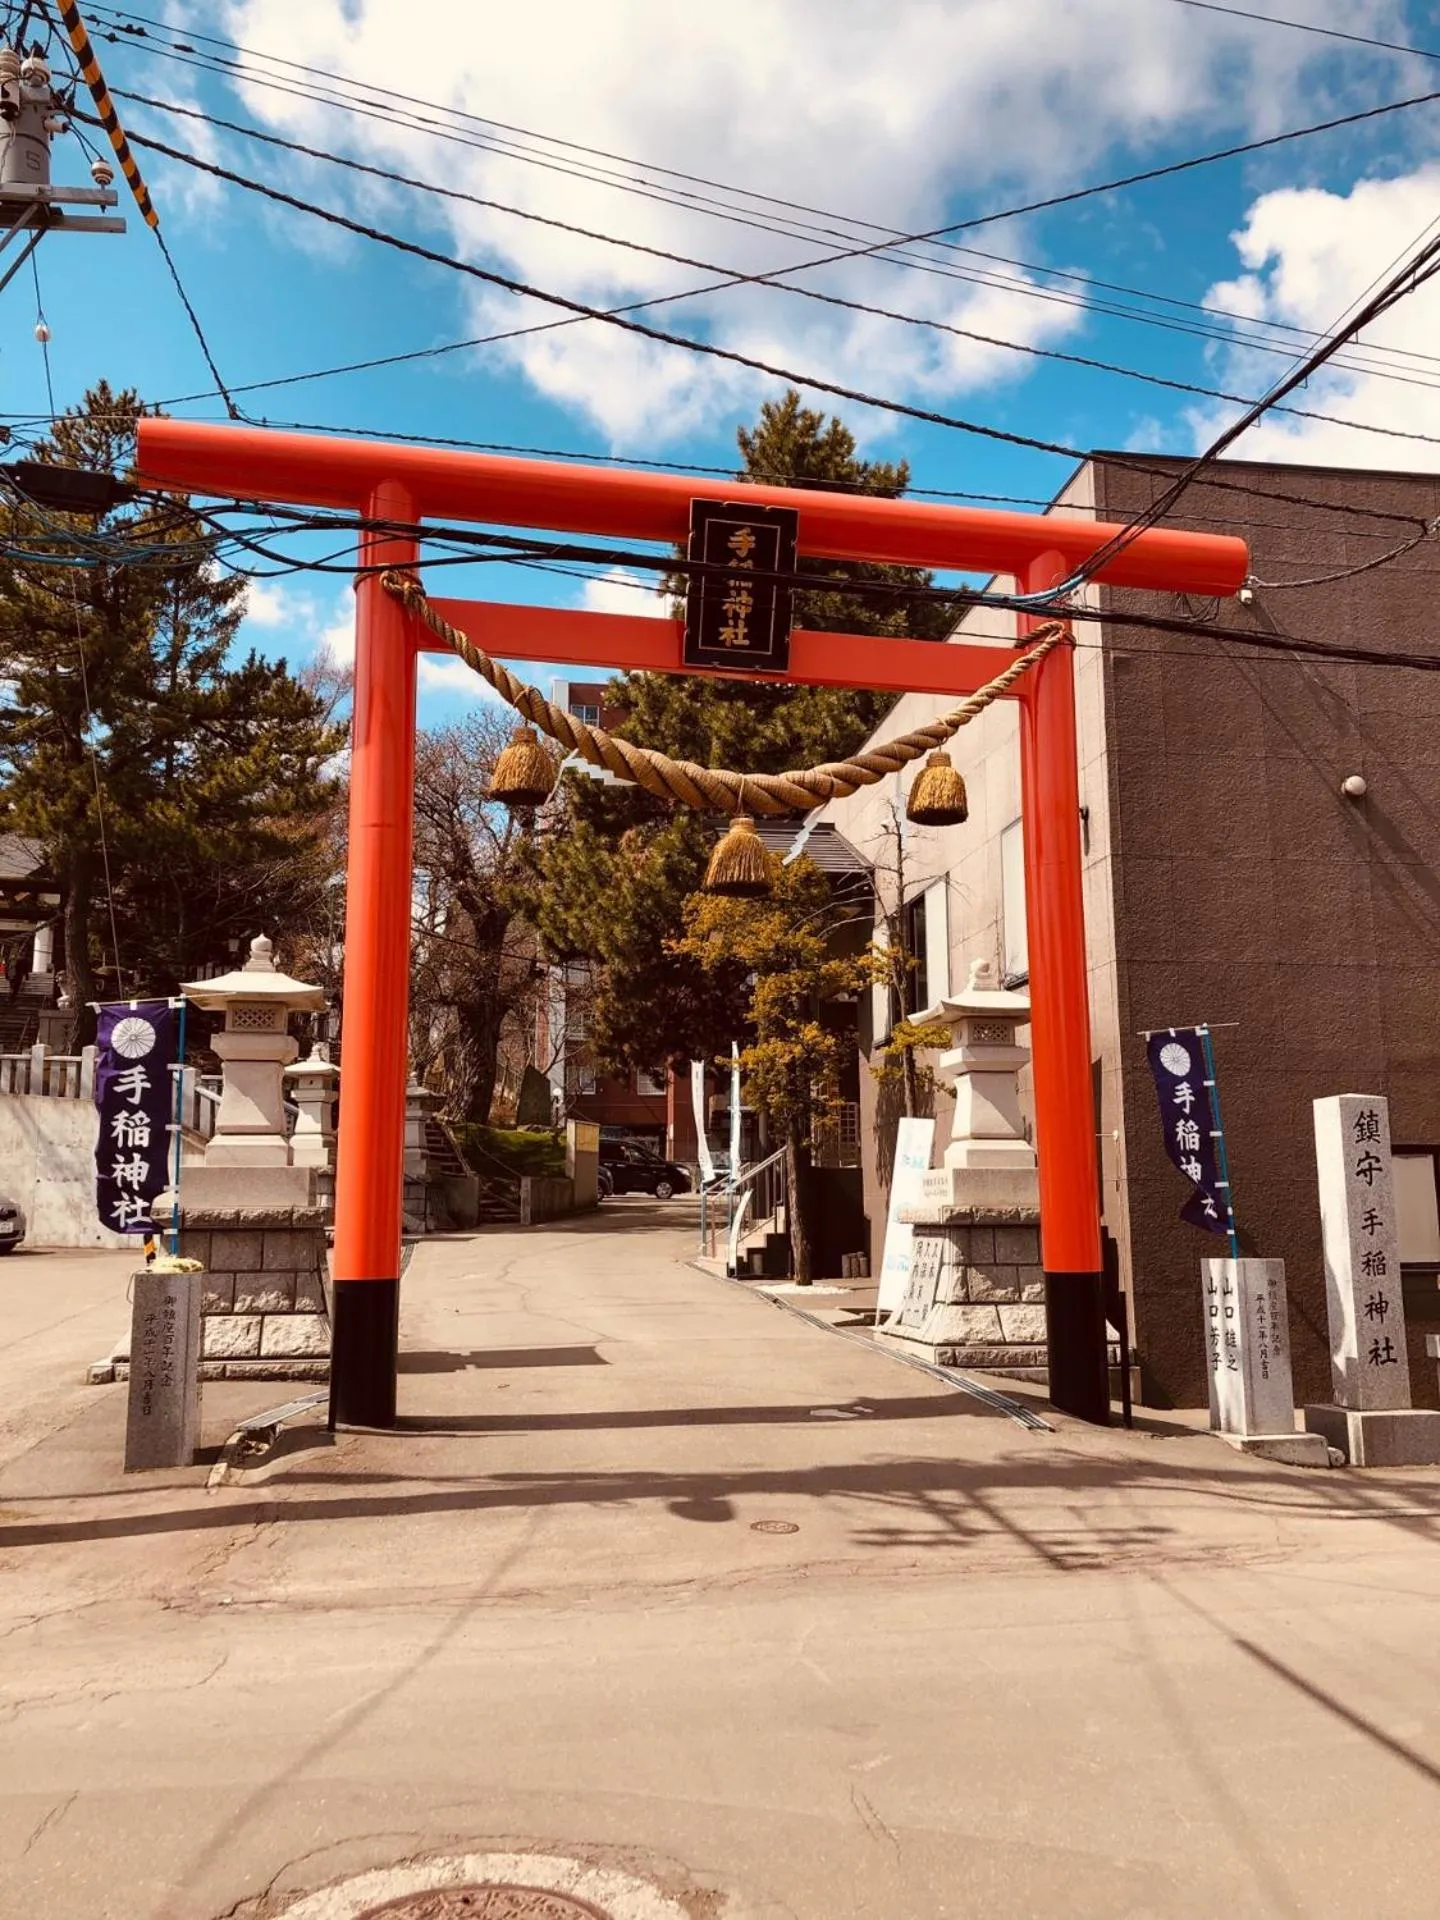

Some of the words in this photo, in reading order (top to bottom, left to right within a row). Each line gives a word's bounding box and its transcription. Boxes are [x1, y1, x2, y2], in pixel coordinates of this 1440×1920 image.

[110, 1065, 152, 1227] 手稲神社
[1208, 1276, 1223, 1371] 山口芳子
